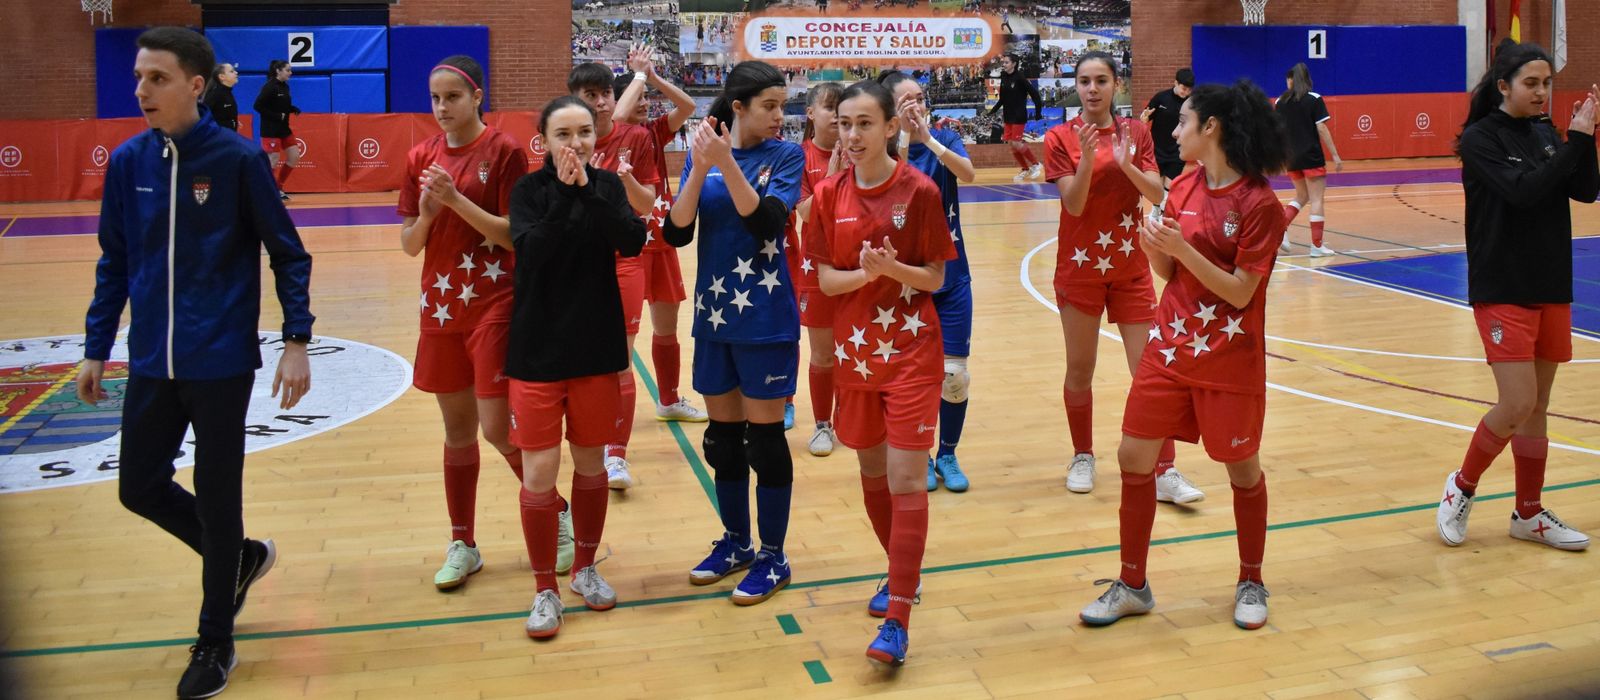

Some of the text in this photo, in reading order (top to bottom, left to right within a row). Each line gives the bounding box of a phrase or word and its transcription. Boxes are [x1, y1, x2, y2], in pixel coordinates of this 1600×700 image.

[805, 20, 927, 33] CONCEJALÍA
[290, 36, 312, 63] 2
[786, 35, 946, 49] DEPORTE Y SALUD
[1310, 33, 1321, 55] 1
